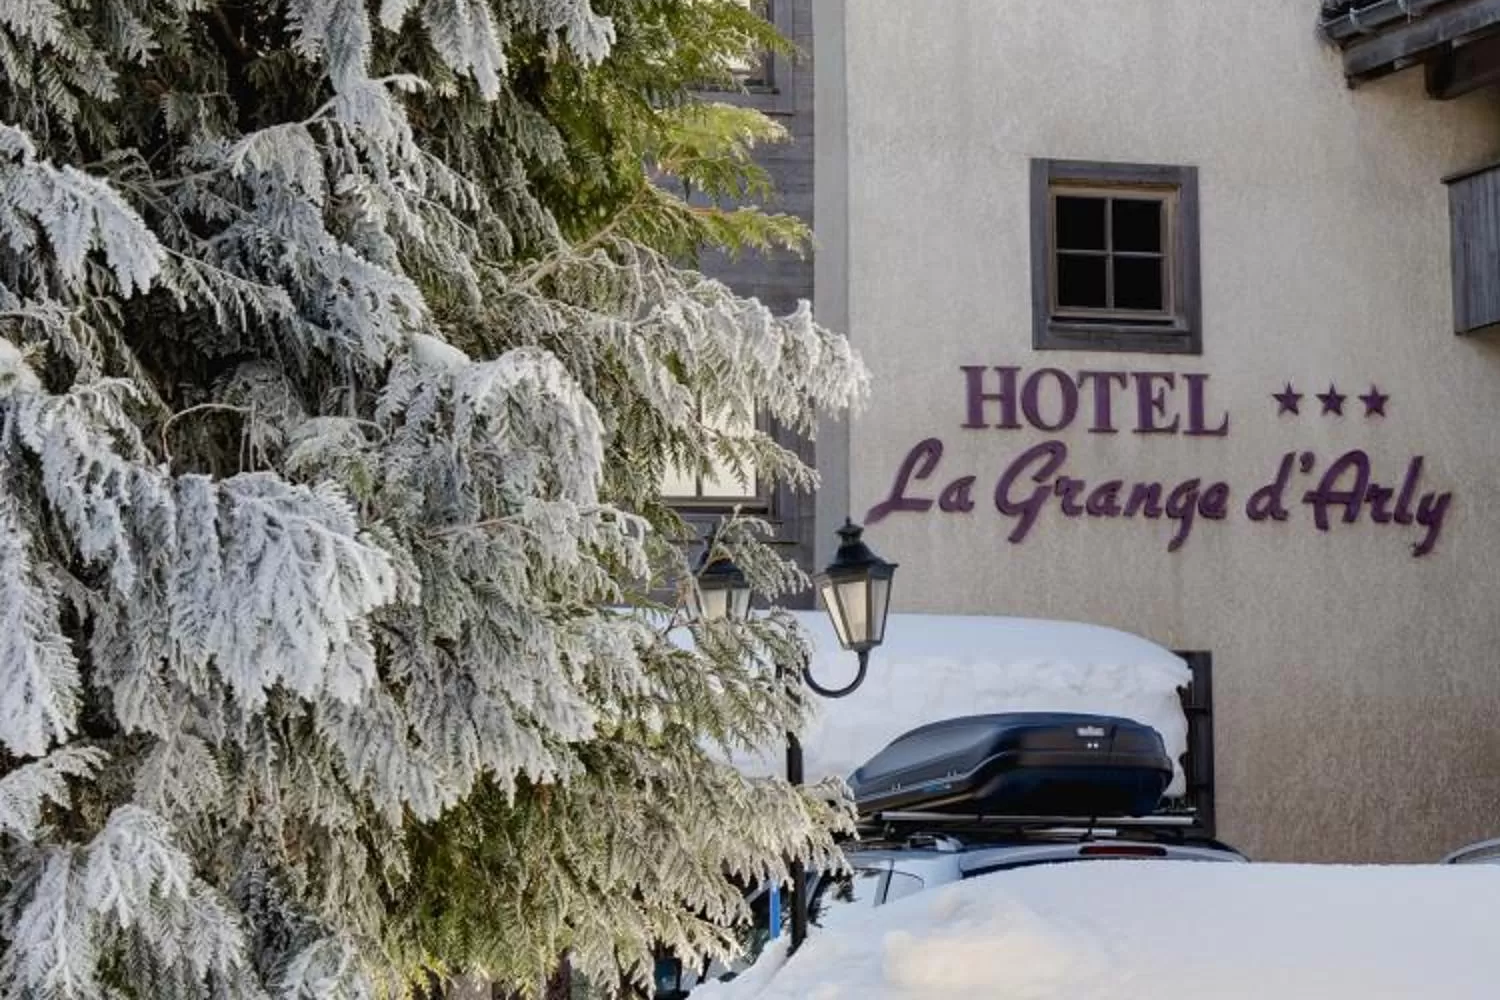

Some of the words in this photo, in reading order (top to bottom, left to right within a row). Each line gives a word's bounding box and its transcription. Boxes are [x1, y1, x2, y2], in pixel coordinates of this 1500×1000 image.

[960, 365, 1229, 437] HOTEL
[864, 437, 977, 525] La
[993, 439, 1228, 553] Grange
[1245, 449, 1452, 557] d'Arly
